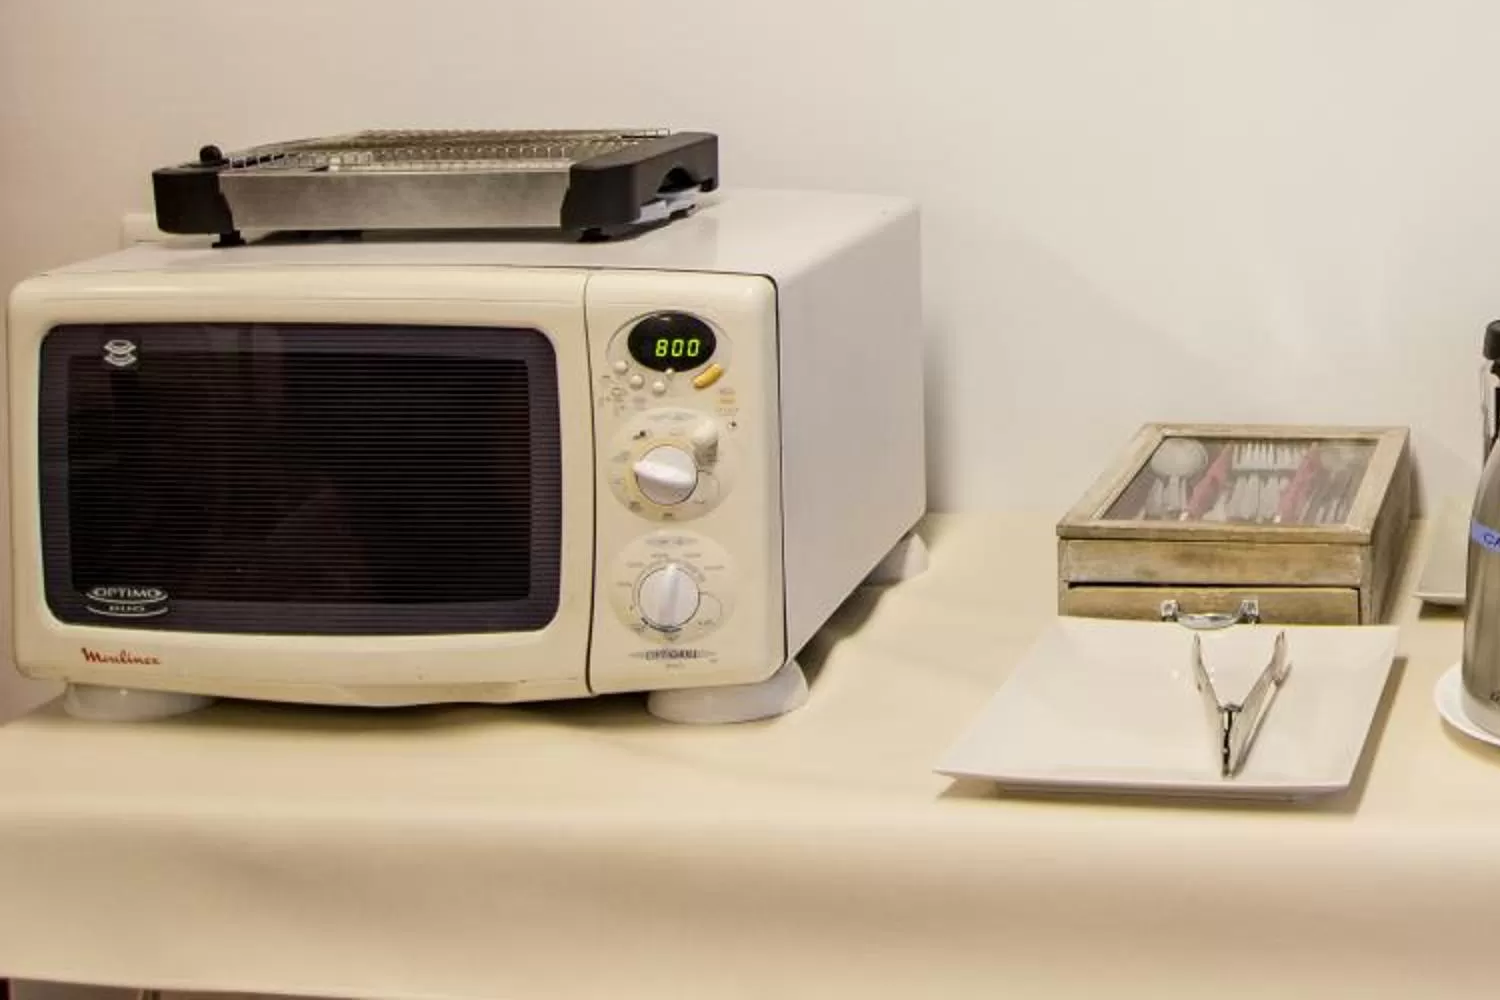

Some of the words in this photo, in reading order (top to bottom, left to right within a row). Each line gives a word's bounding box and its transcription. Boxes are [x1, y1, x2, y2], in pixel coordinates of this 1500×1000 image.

[655, 338, 701, 357] 800
[92, 587, 164, 598] OPTIMO
[81, 647, 161, 665] Moulinex
